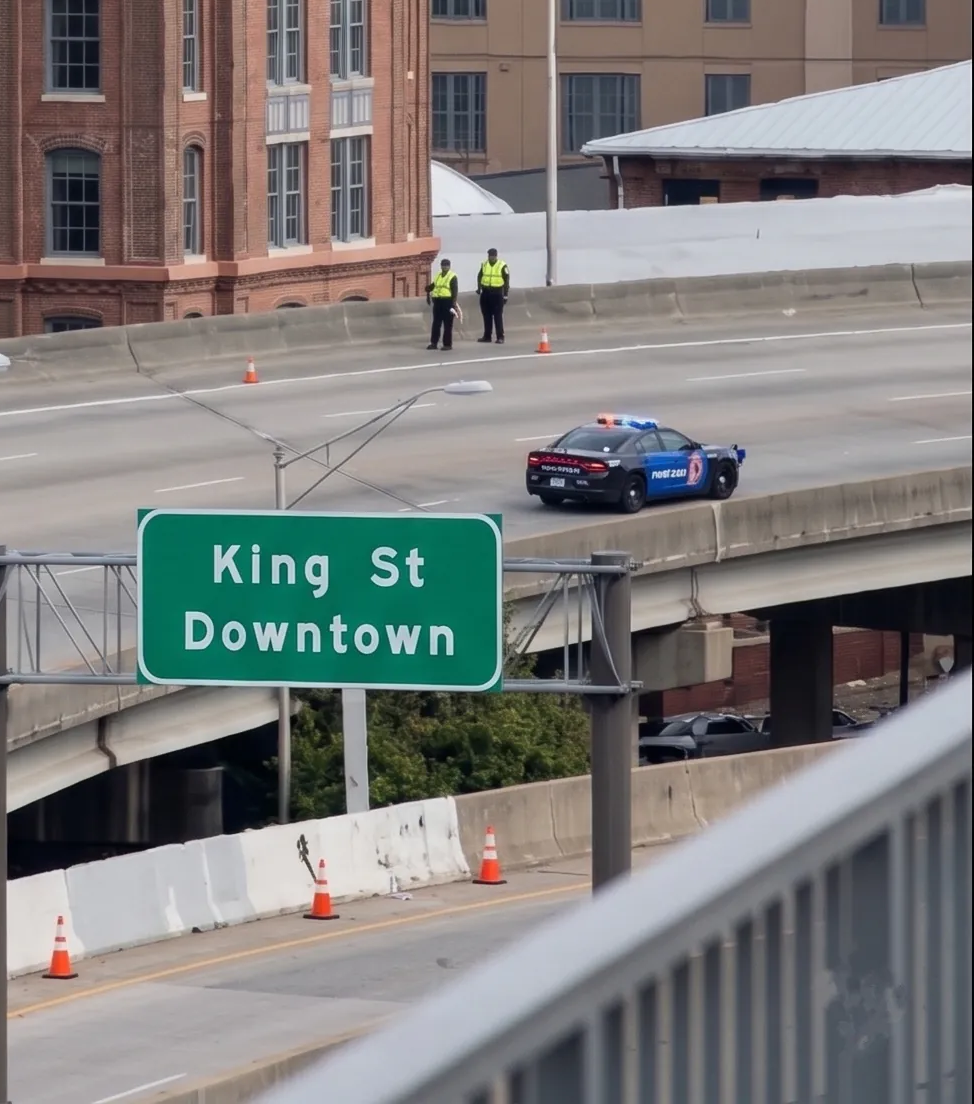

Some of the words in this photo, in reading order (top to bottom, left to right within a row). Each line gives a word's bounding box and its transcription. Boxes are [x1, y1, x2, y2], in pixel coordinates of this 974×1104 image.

[214, 544, 328, 598] King
[371, 547, 424, 587] St
[185, 612, 453, 655] Downtown
